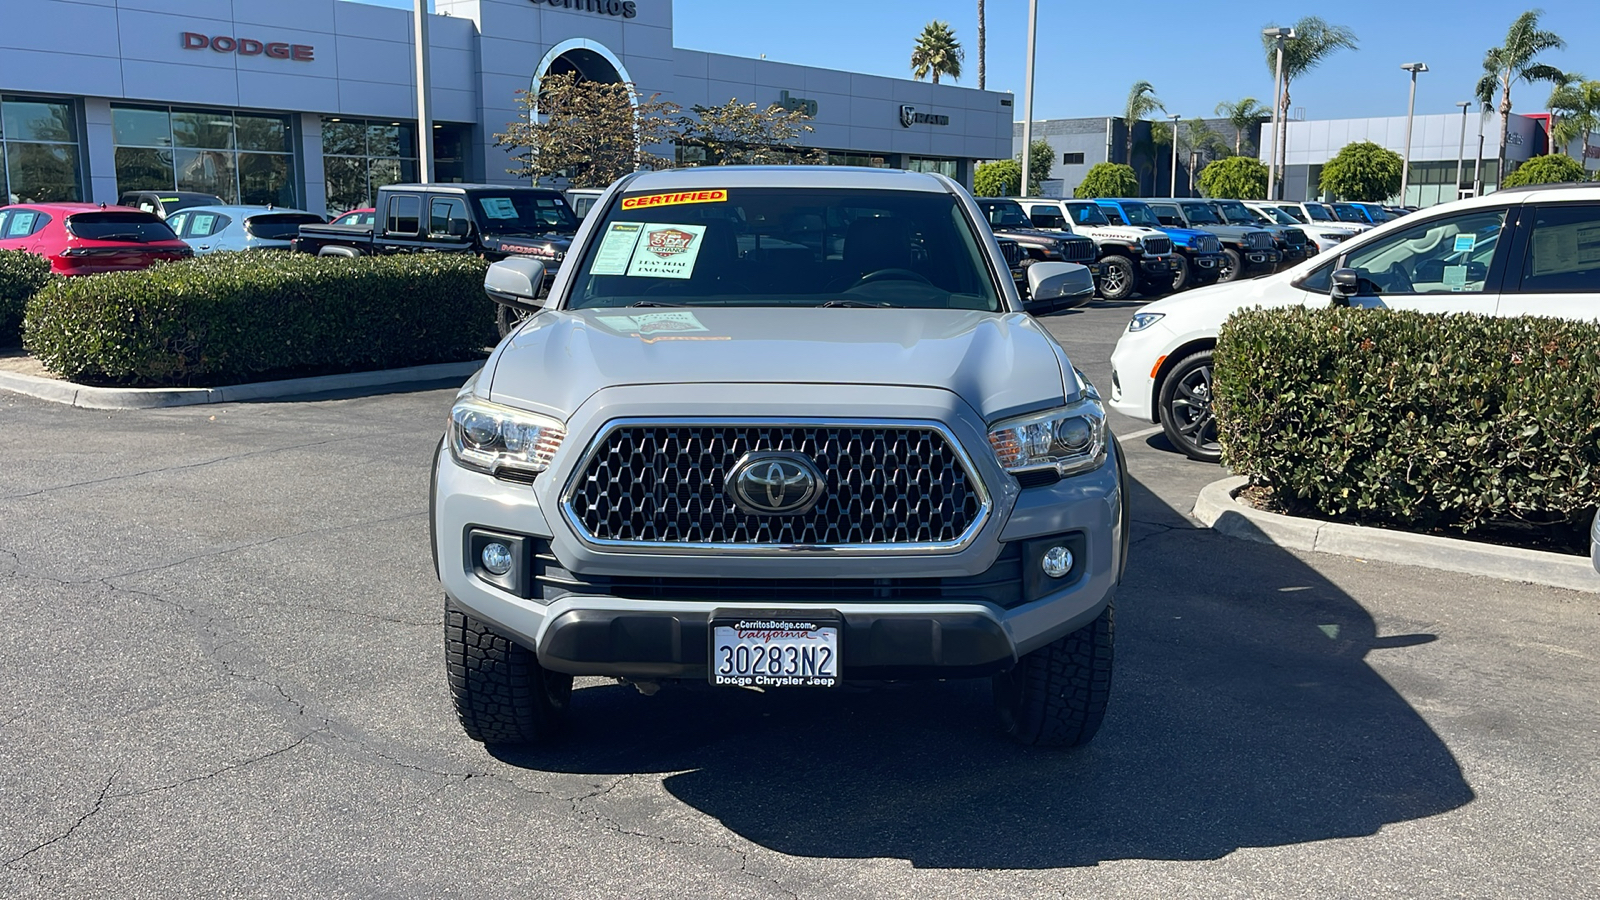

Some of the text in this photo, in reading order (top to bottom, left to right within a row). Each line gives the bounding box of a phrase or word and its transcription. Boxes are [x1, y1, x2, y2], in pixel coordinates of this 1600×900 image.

[527, 0, 637, 19] ritos
[182, 31, 314, 61] DODGE
[775, 90, 818, 117] Jeep
[916, 113, 949, 126] RAM
[623, 191, 724, 208] CERTIFIED
[651, 232, 690, 248] 3 DAY
[501, 243, 555, 256] MOJAVE
[646, 246, 687, 254] EXCHANGE
[740, 620, 812, 630] CerritosDodge.com
[738, 629, 817, 643] California
[719, 645, 832, 675] 30283N2
[716, 675, 835, 687] Dodge Chrysler Jeep
